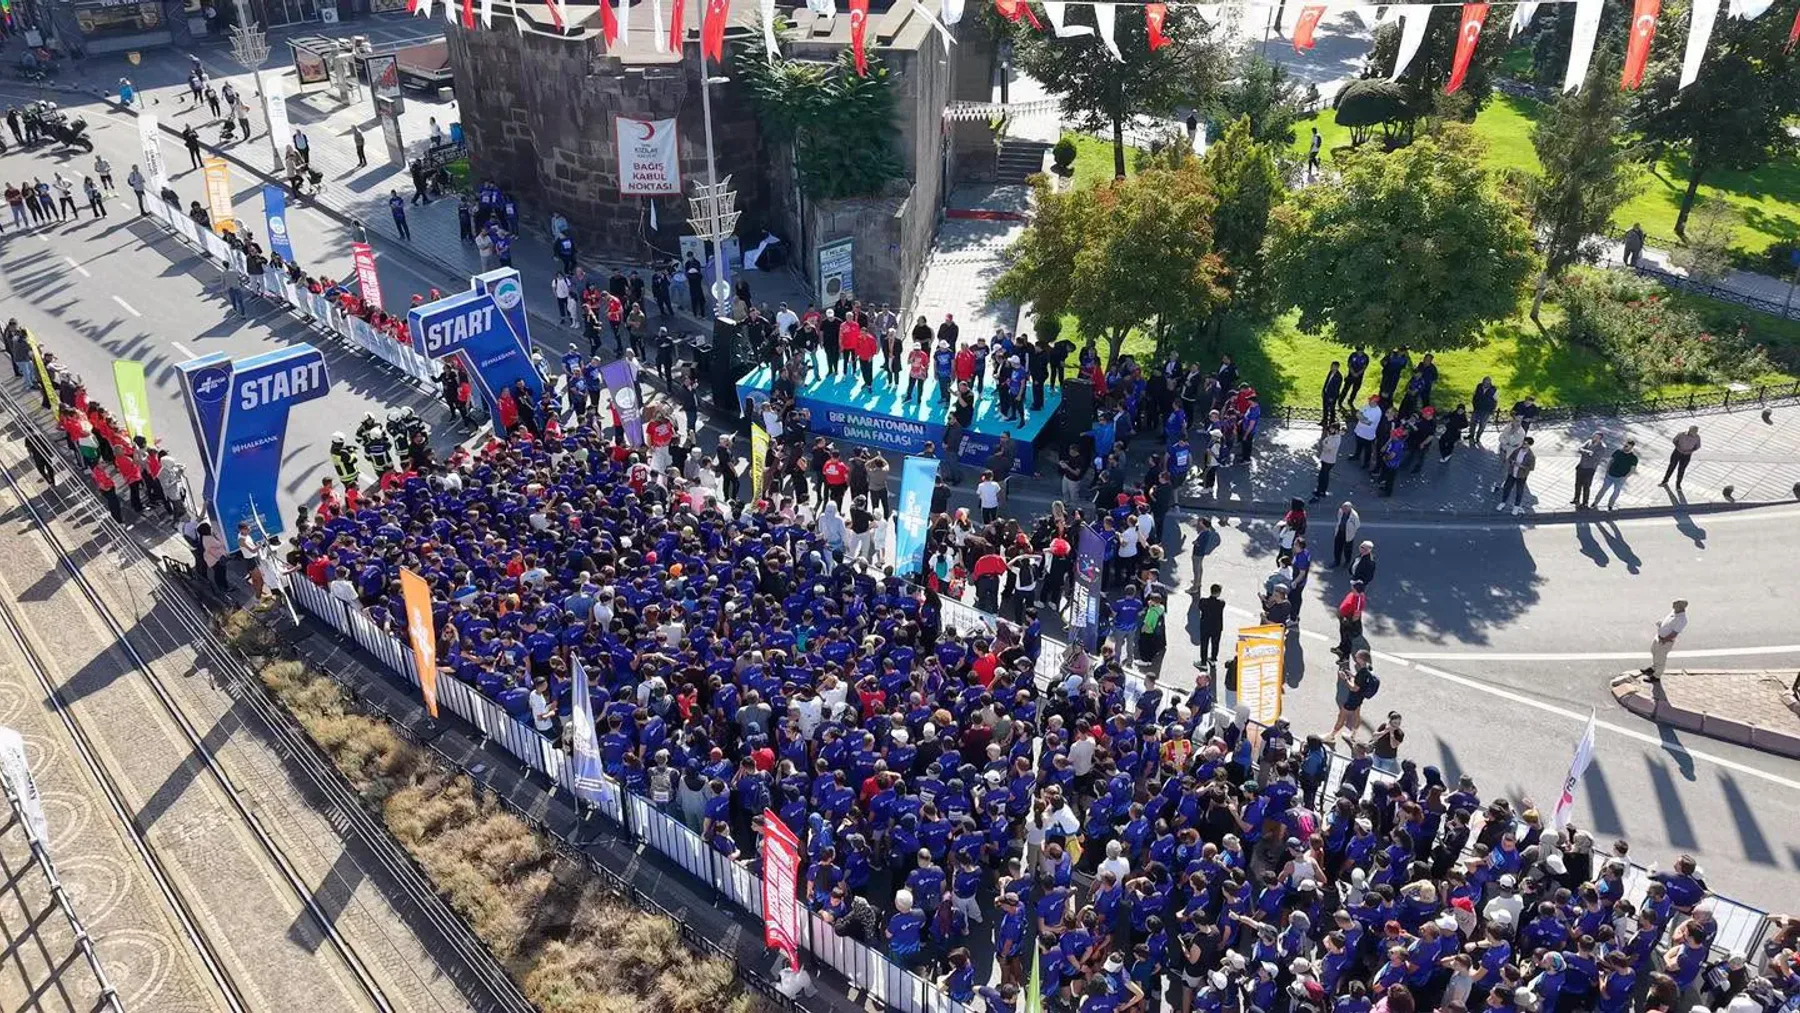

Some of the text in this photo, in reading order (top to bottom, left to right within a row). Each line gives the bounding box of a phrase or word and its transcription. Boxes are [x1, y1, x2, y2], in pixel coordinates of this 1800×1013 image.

[632, 173, 667, 181] KABUL
[633, 162, 664, 172] BAĞIŞ
[428, 304, 495, 351] START
[241, 360, 323, 410] START
[847, 414, 924, 435] MARATONDAN
[240, 435, 279, 450] HALKBANK
[843, 426, 912, 446] DAHA FAZLASI
